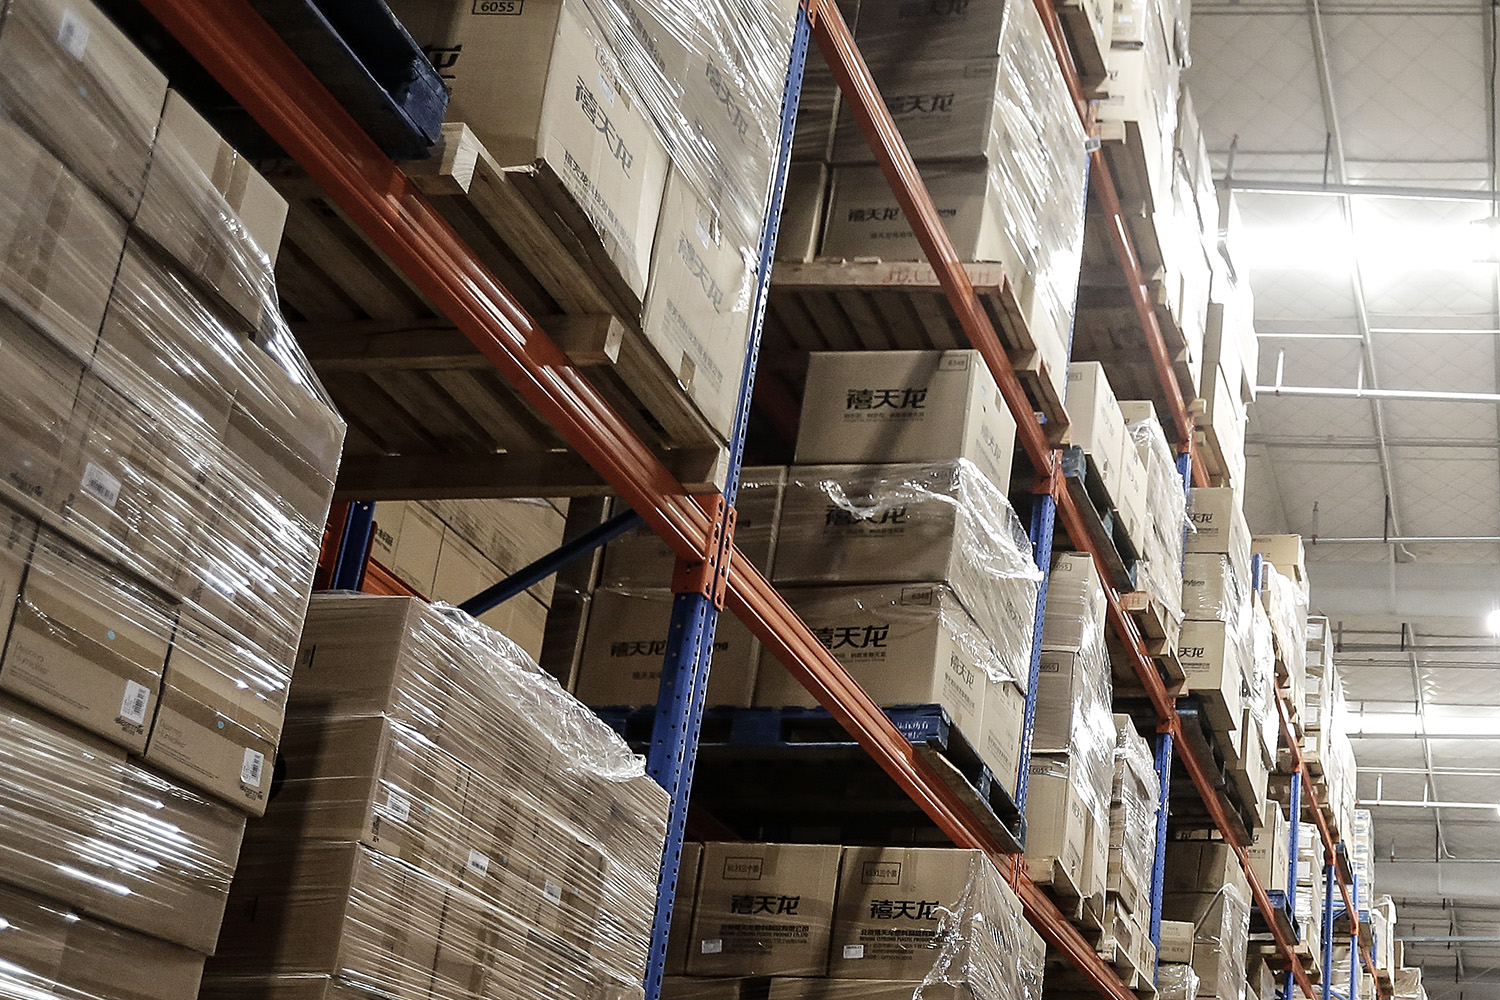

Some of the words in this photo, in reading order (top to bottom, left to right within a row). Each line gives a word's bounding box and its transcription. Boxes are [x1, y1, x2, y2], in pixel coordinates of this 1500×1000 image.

[575, 75, 633, 180] 禧天龙
[846, 387, 928, 410] 禧天龙
[730, 895, 801, 916] 禧天龙
[870, 899, 941, 920] 禧天龙
